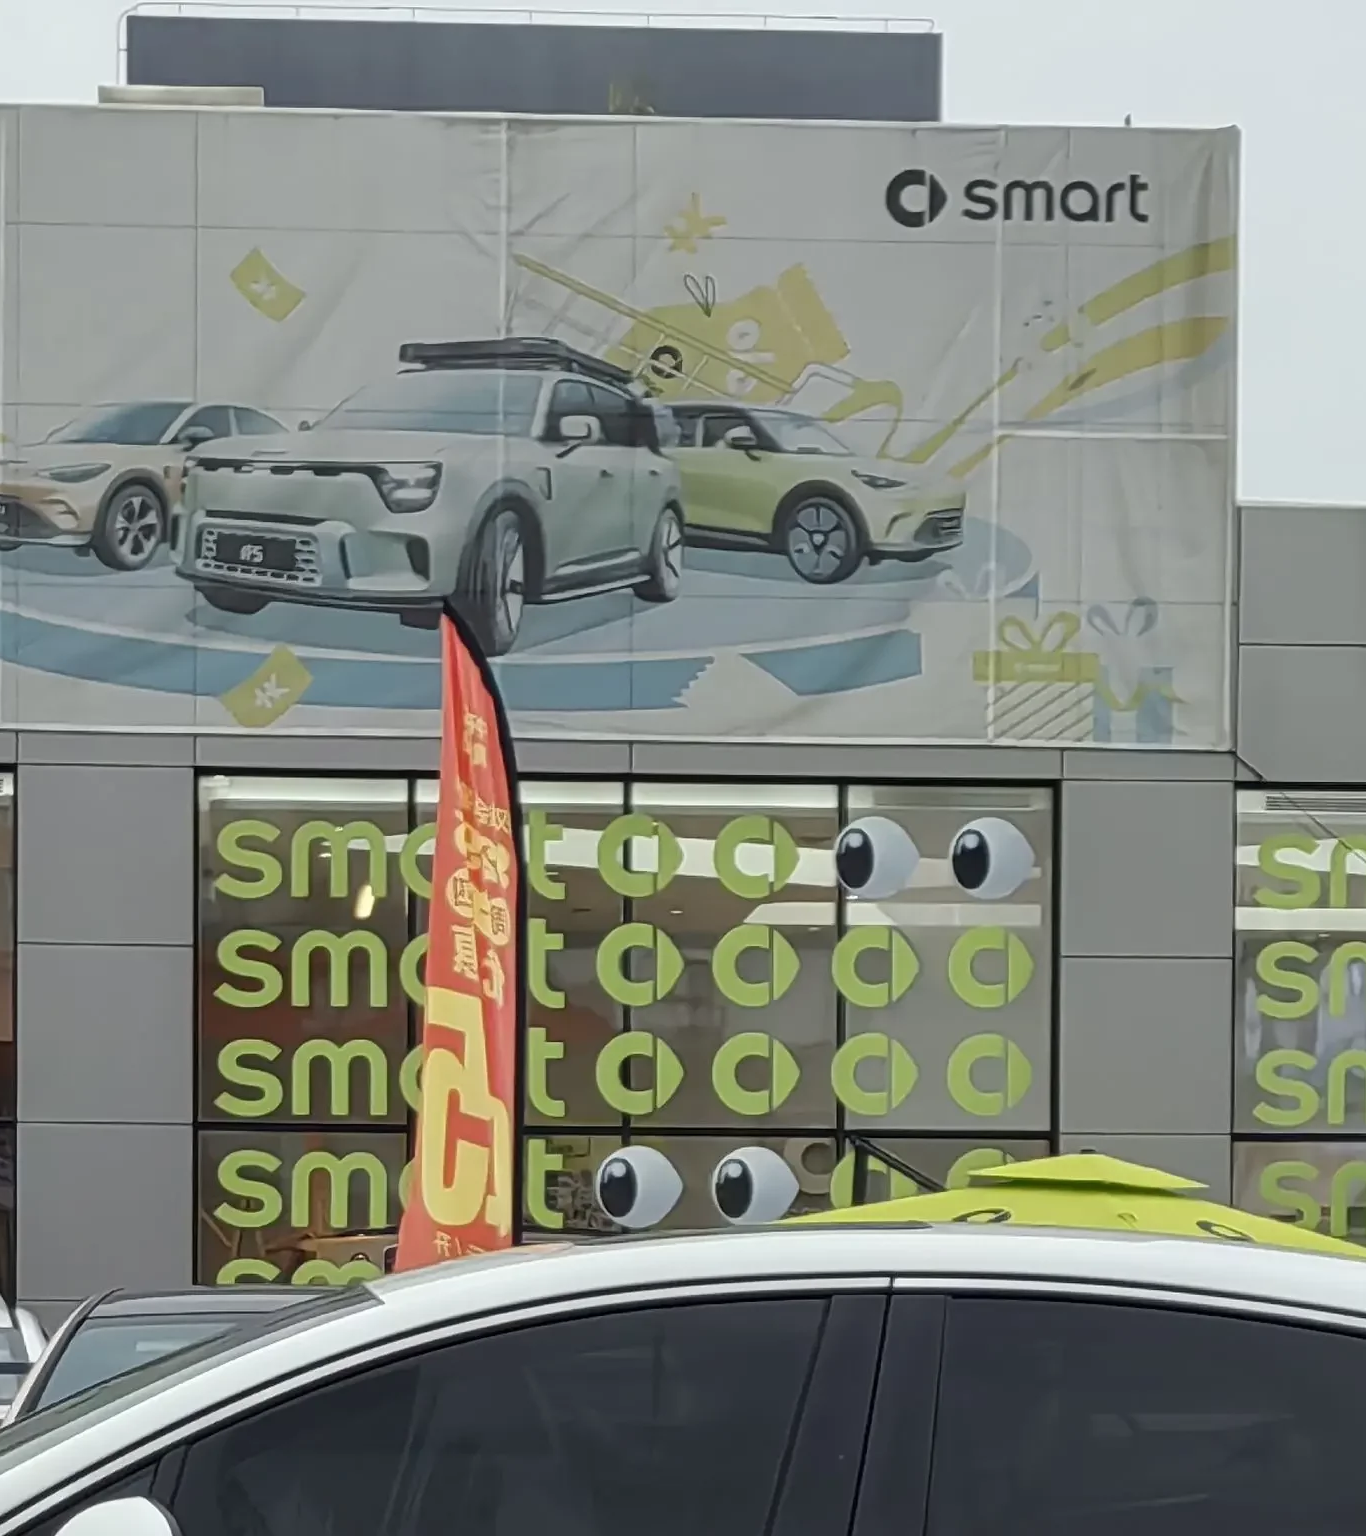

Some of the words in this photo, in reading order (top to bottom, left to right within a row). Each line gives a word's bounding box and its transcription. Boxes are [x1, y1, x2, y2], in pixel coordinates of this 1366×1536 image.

[962, 174, 1149, 223] smart
[214, 810, 566, 900] smt
[213, 918, 566, 1009] smt
[213, 1027, 566, 1118] smt
[213, 1138, 565, 1230] smt
